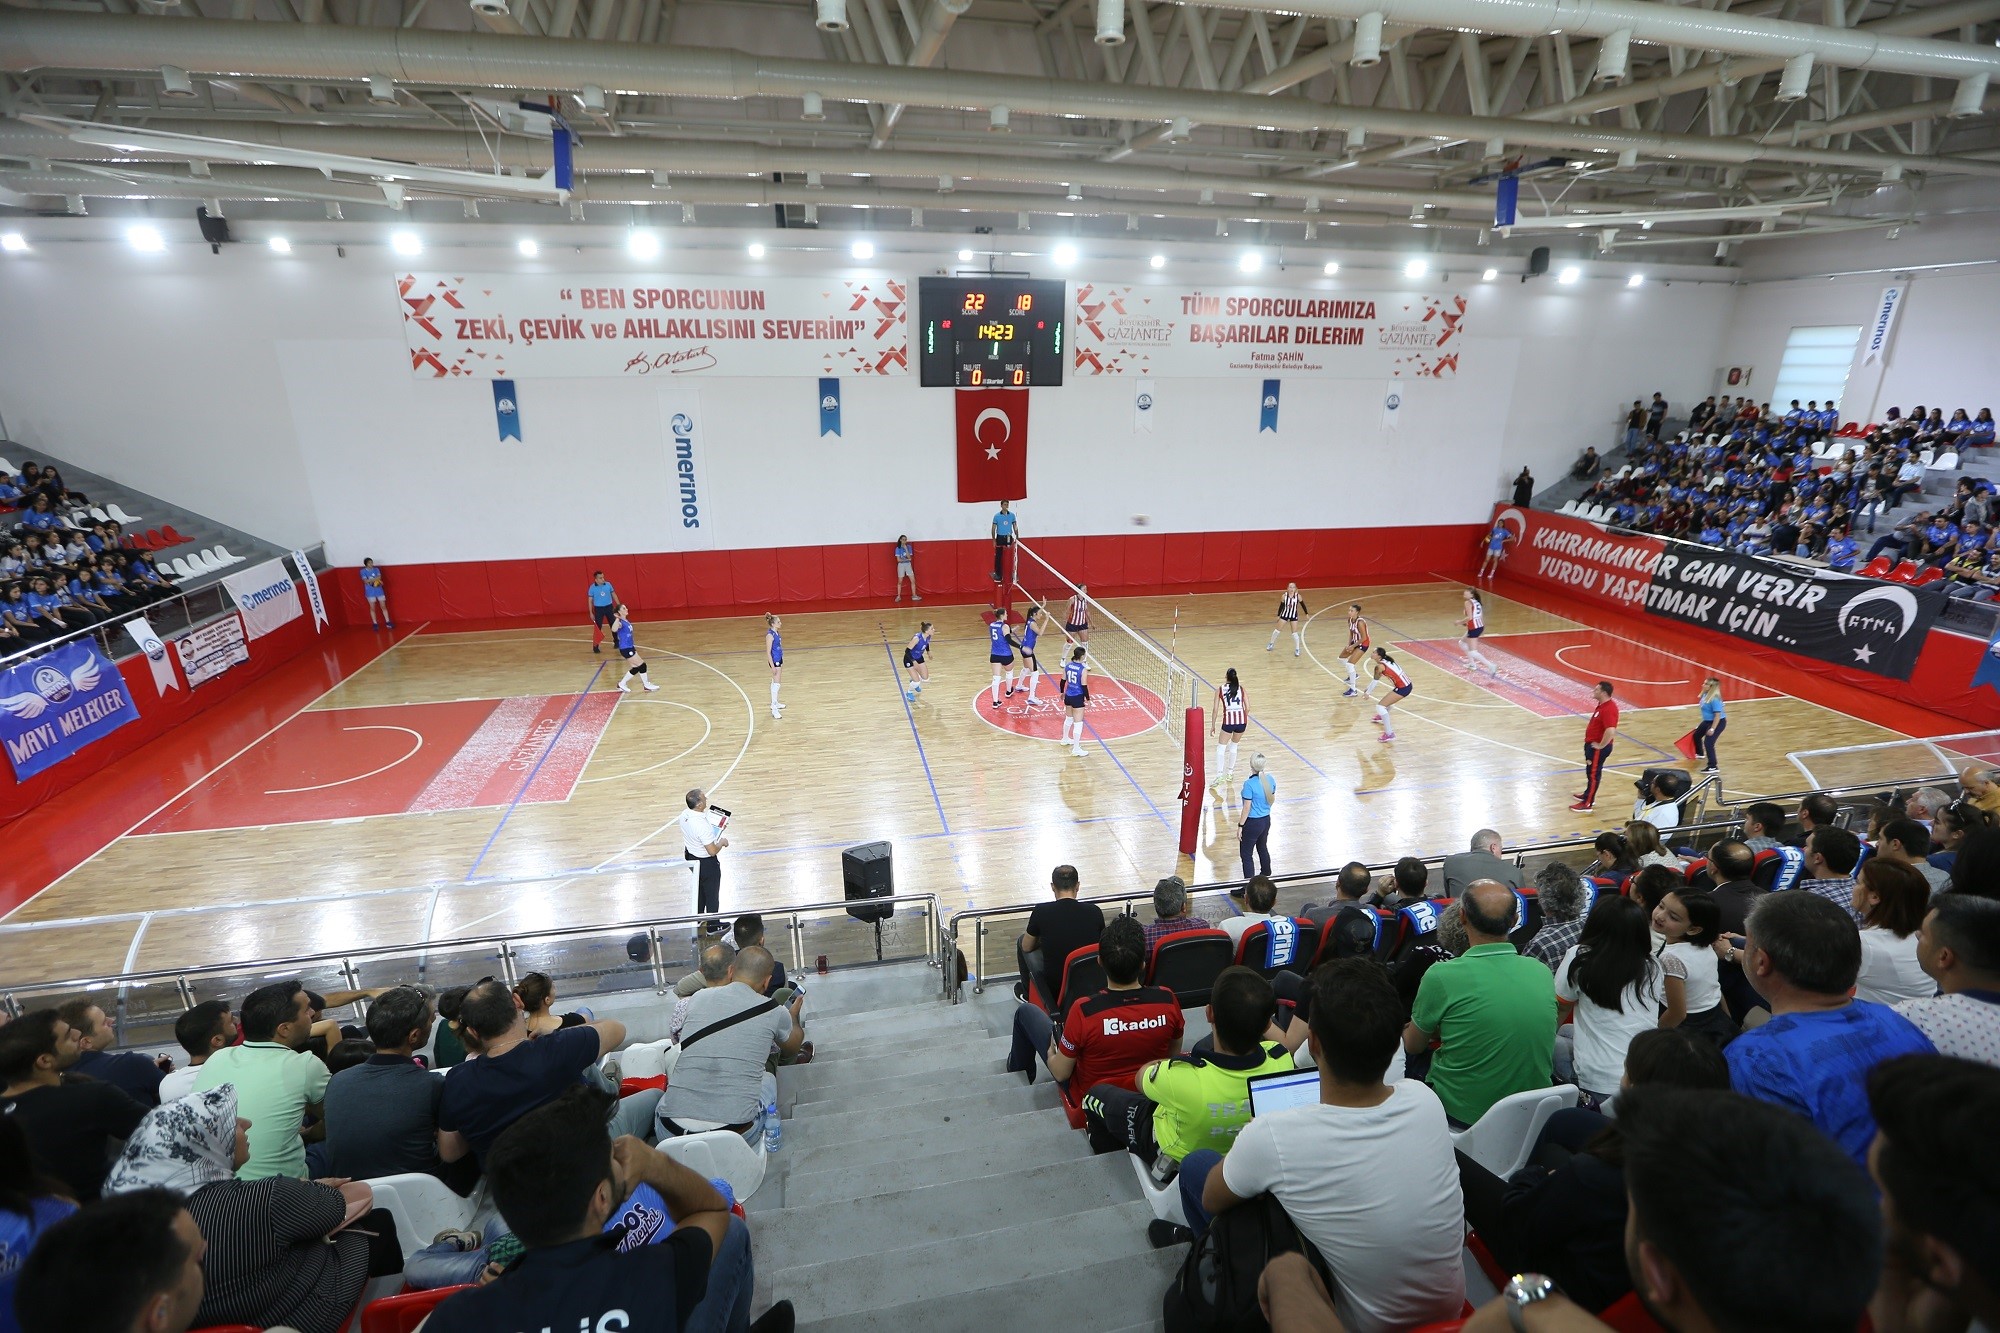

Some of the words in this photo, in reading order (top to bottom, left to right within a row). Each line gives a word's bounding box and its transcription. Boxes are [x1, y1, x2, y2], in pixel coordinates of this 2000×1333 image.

[581, 288, 626, 309] BEN
[632, 288, 765, 310] SPORCUNUN
[965, 294, 985, 310] 22
[1018, 294, 1032, 311] 18
[1181, 291, 1220, 316] TÜM
[1226, 296, 1376, 320] SPORCULARIMIZA
[454, 314, 514, 344] ZEKİ,
[519, 314, 586, 346] ÇEVİK
[591, 323, 617, 339] ve
[623, 317, 756, 340] AHLAKLISINI
[979, 325, 1014, 340] 14:23
[1190, 323, 1289, 349] BAŞARILAR
[1871, 301, 1894, 351] merinos
[1251, 352, 1275, 361] Fatma
[1277, 350, 1304, 363] ŞAHİN
[675, 437, 700, 529] merinos
[1532, 527, 1680, 580] KAHRAMANLAR
[1680, 560, 1737, 590] CAN
[1736, 570, 1828, 614] VERİR
[252, 578, 292, 606] merinos
[301, 563, 323, 615] merinos
[1538, 555, 1599, 589] YURDU
[1600, 573, 1718, 622] YAŞATMAK
[1717, 596, 1780, 639] İÇİN
[992, 628, 998, 640] 5
[1067, 670, 1078, 684] 15
[58, 688, 126, 738] MELEKLER
